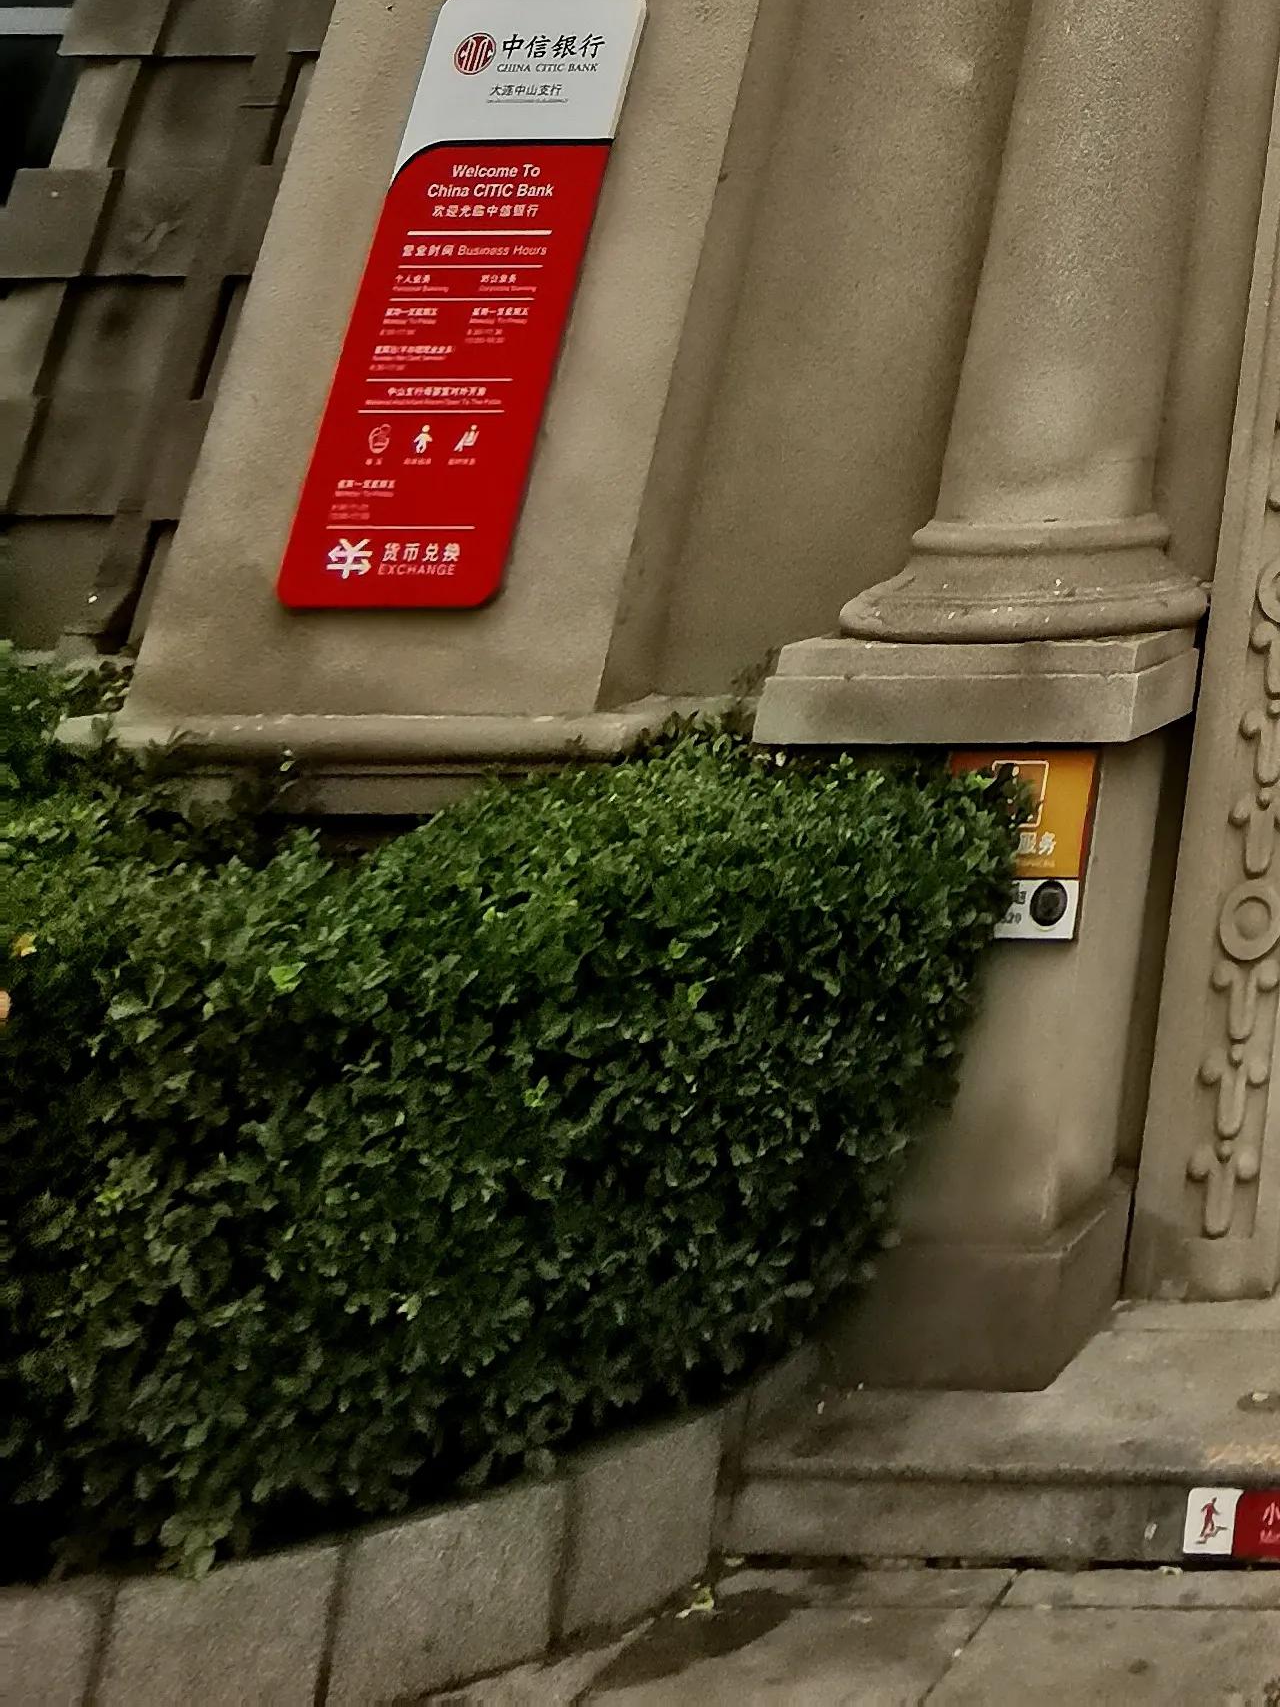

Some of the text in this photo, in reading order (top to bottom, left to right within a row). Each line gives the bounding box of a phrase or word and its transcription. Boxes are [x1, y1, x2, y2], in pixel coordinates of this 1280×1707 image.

[502, 33, 605, 59] 中信银行
[496, 63, 600, 73] CHINA CITIC BANK
[490, 83, 563, 96] 大连中山支行
[452, 164, 541, 179] Welcome To
[427, 183, 554, 198] China CITIC Bank
[432, 204, 539, 218] 欢迎光临中信银行
[402, 244, 547, 257] 营业时间 Business Hours
[382, 542, 461, 563] 货币兑换
[378, 563, 457, 577] EXCHANGE
